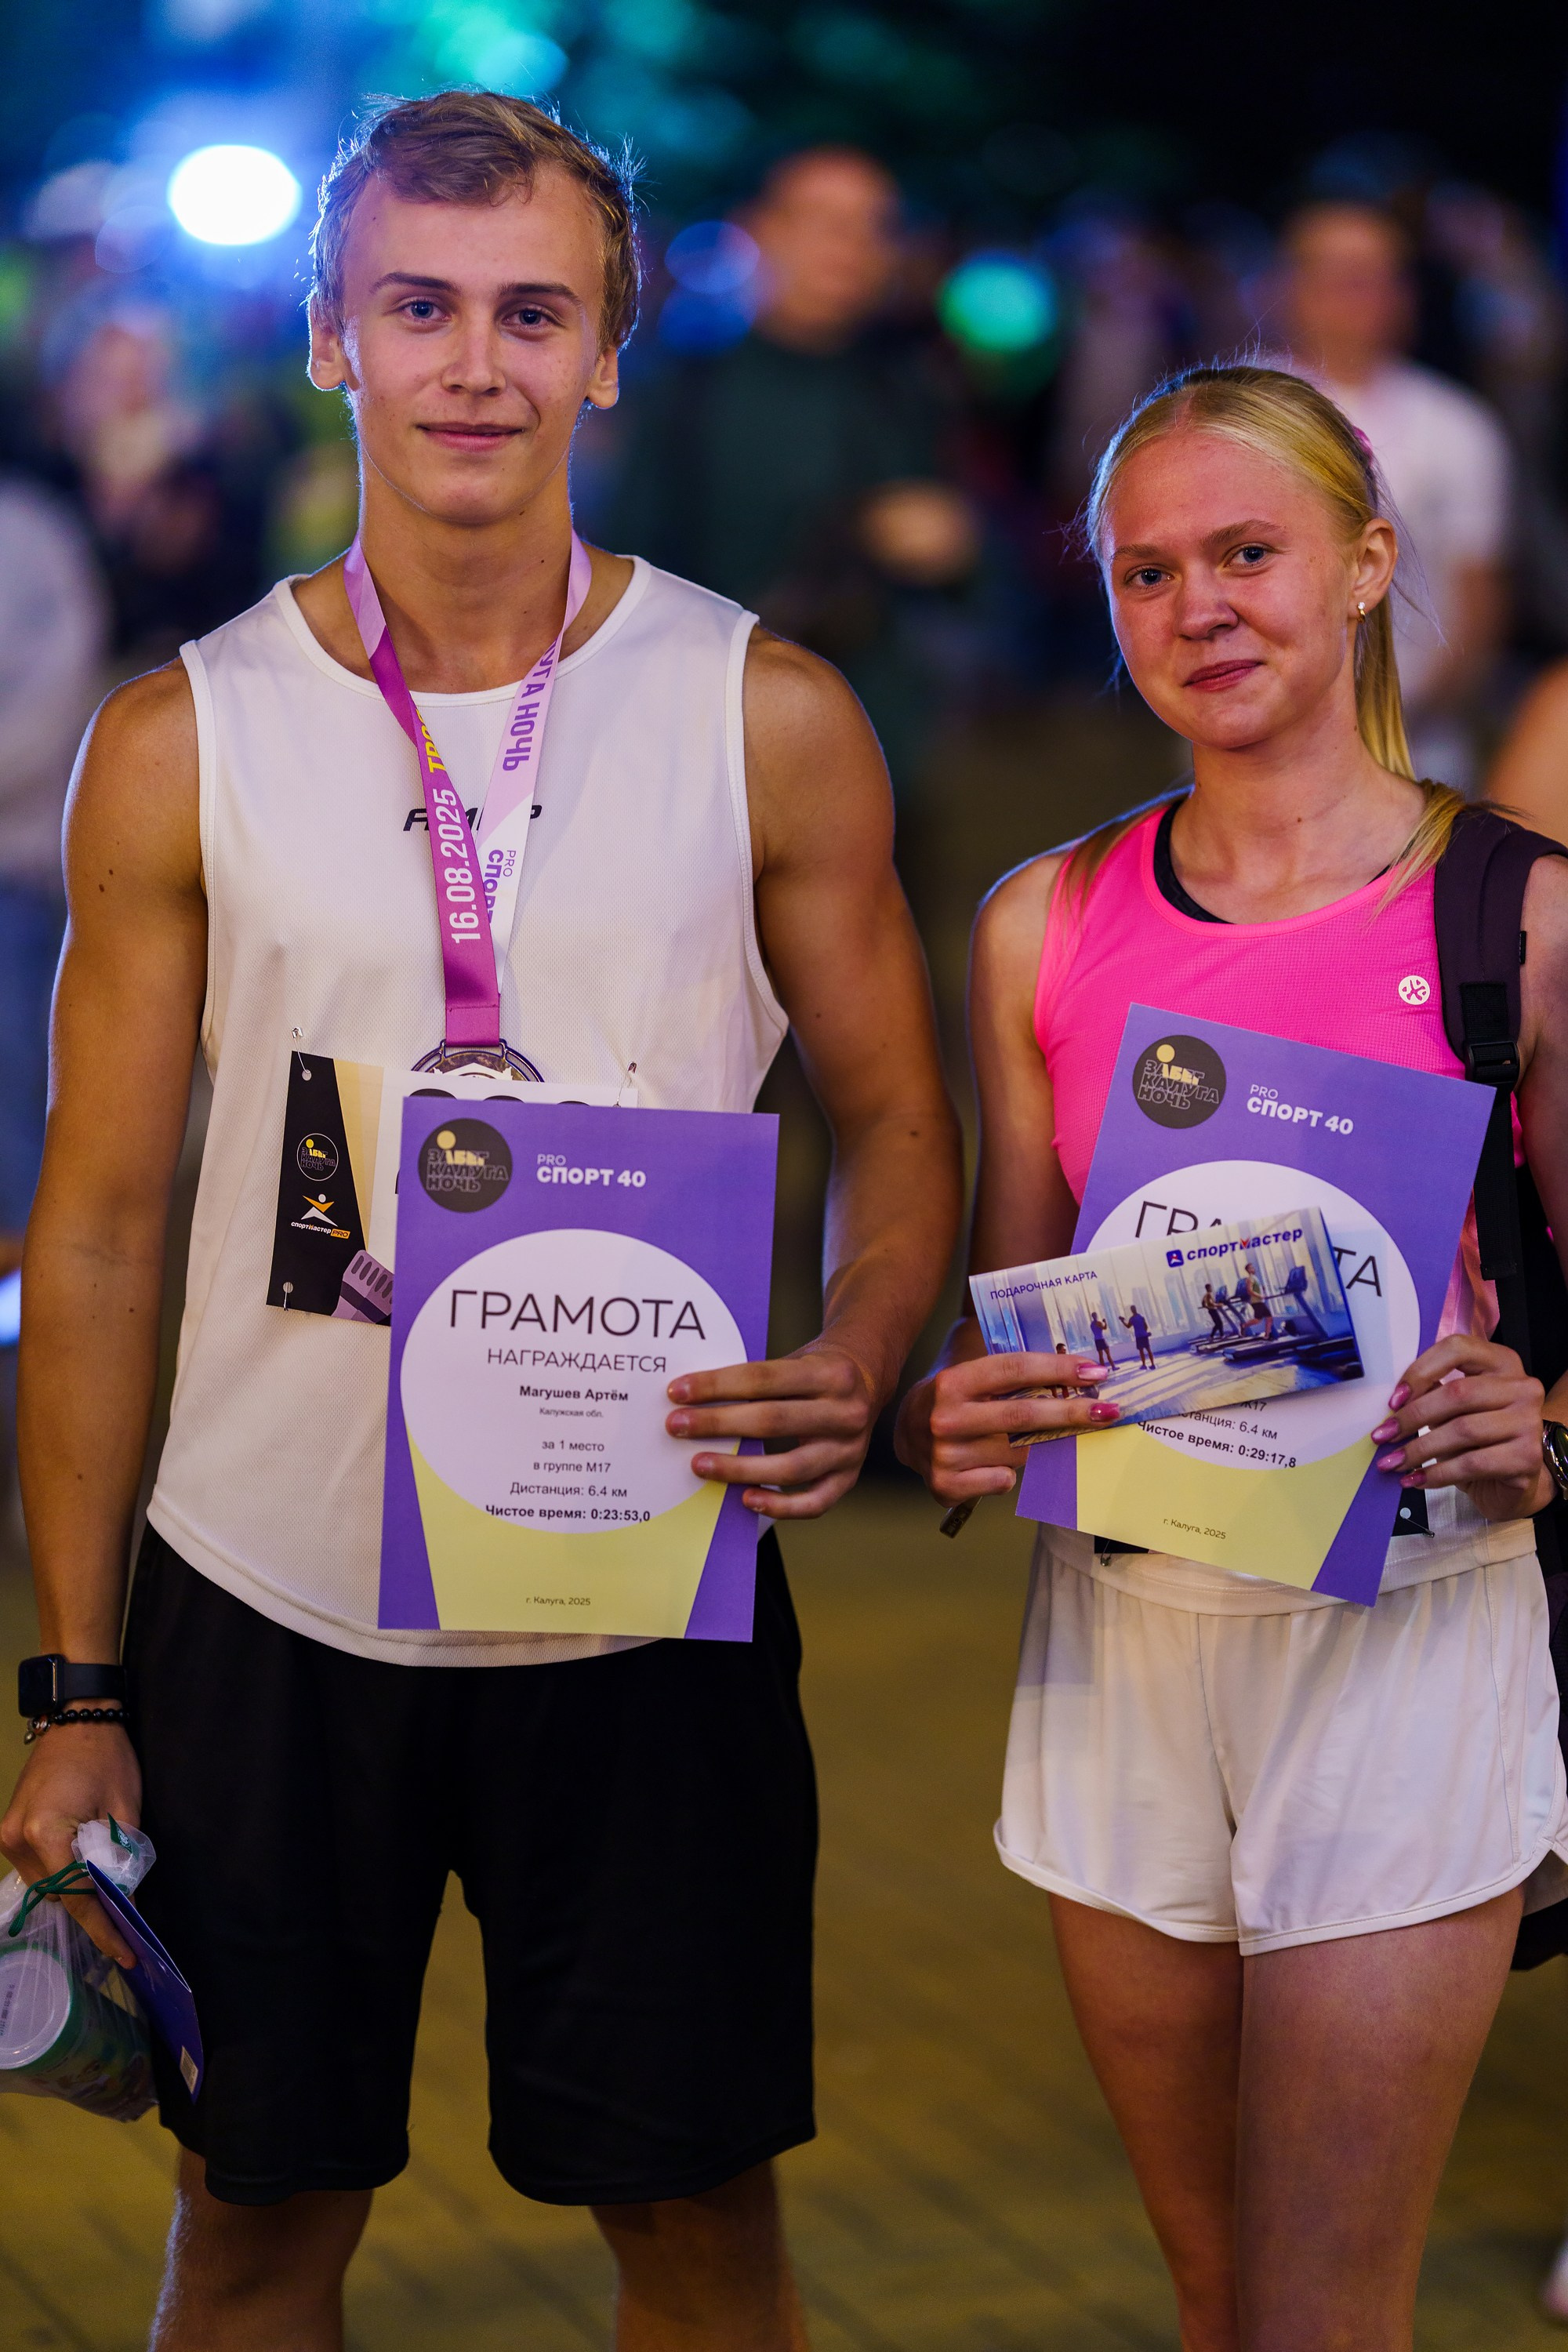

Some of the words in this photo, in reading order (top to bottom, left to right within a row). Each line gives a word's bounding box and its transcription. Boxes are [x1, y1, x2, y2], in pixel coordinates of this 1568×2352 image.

[503, 702, 540, 771] НОЧЬ
[433, 788, 481, 944] 16.08.2025
[503, 850, 517, 877] PRO
[1144, 1059, 1206, 1086] ЗАБЕГ
[1137, 1085, 1191, 1110] НОЧЬ
[1140, 1072, 1220, 1104] КАЛУГА
[1250, 1083, 1279, 1099] PRO
[1247, 1097, 1324, 1127] СПОРТ
[1324, 1115, 1354, 1135] 40
[300, 1160, 324, 1171] НОЧЬ
[537, 1153, 567, 1167] PRO
[426, 1161, 509, 1181] КАЛУГА
[536, 1166, 614, 1186] СПОРТ
[617, 1170, 647, 1188] 40
[426, 1176, 481, 1192] НОЧЬ
[332, 1229, 349, 1238] PRO
[990, 1277, 1062, 1300] ПОДАРОЧНАЯ
[1065, 1271, 1098, 1285] КАРТА
[451, 1289, 706, 1340] ГРАМОТА
[488, 1348, 666, 1373] НАГРАЖДАЕТСЯ
[519, 1385, 581, 1400] Магушев
[585, 1388, 629, 1403] Артём
[539, 1407, 584, 1417] Калужская
[1239, 1421, 1258, 1435] 6.4
[1261, 1428, 1278, 1440] км
[542, 1441, 555, 1450] за
[560, 1440, 564, 1450] 1
[568, 1443, 604, 1452] место
[1138, 1421, 1185, 1440] Чистое
[1188, 1435, 1235, 1453] время:
[1238, 1444, 1297, 1469] 0:29:17,8
[543, 1462, 583, 1473] группе
[586, 1462, 612, 1473] М17
[510, 1482, 584, 1497] Дистанция:
[588, 1485, 608, 1497] 6.4
[612, 1488, 627, 1497] км
[485, 1504, 535, 1517] Чистое
[539, 1508, 586, 1519] время:
[590, 1508, 651, 1523] 0:23:53,0
[1171, 1519, 1202, 1534] Калуга,
[1203, 1527, 1227, 1540] 2025
[534, 1595, 566, 1606] Калуга,
[568, 1597, 591, 1606] 2025
